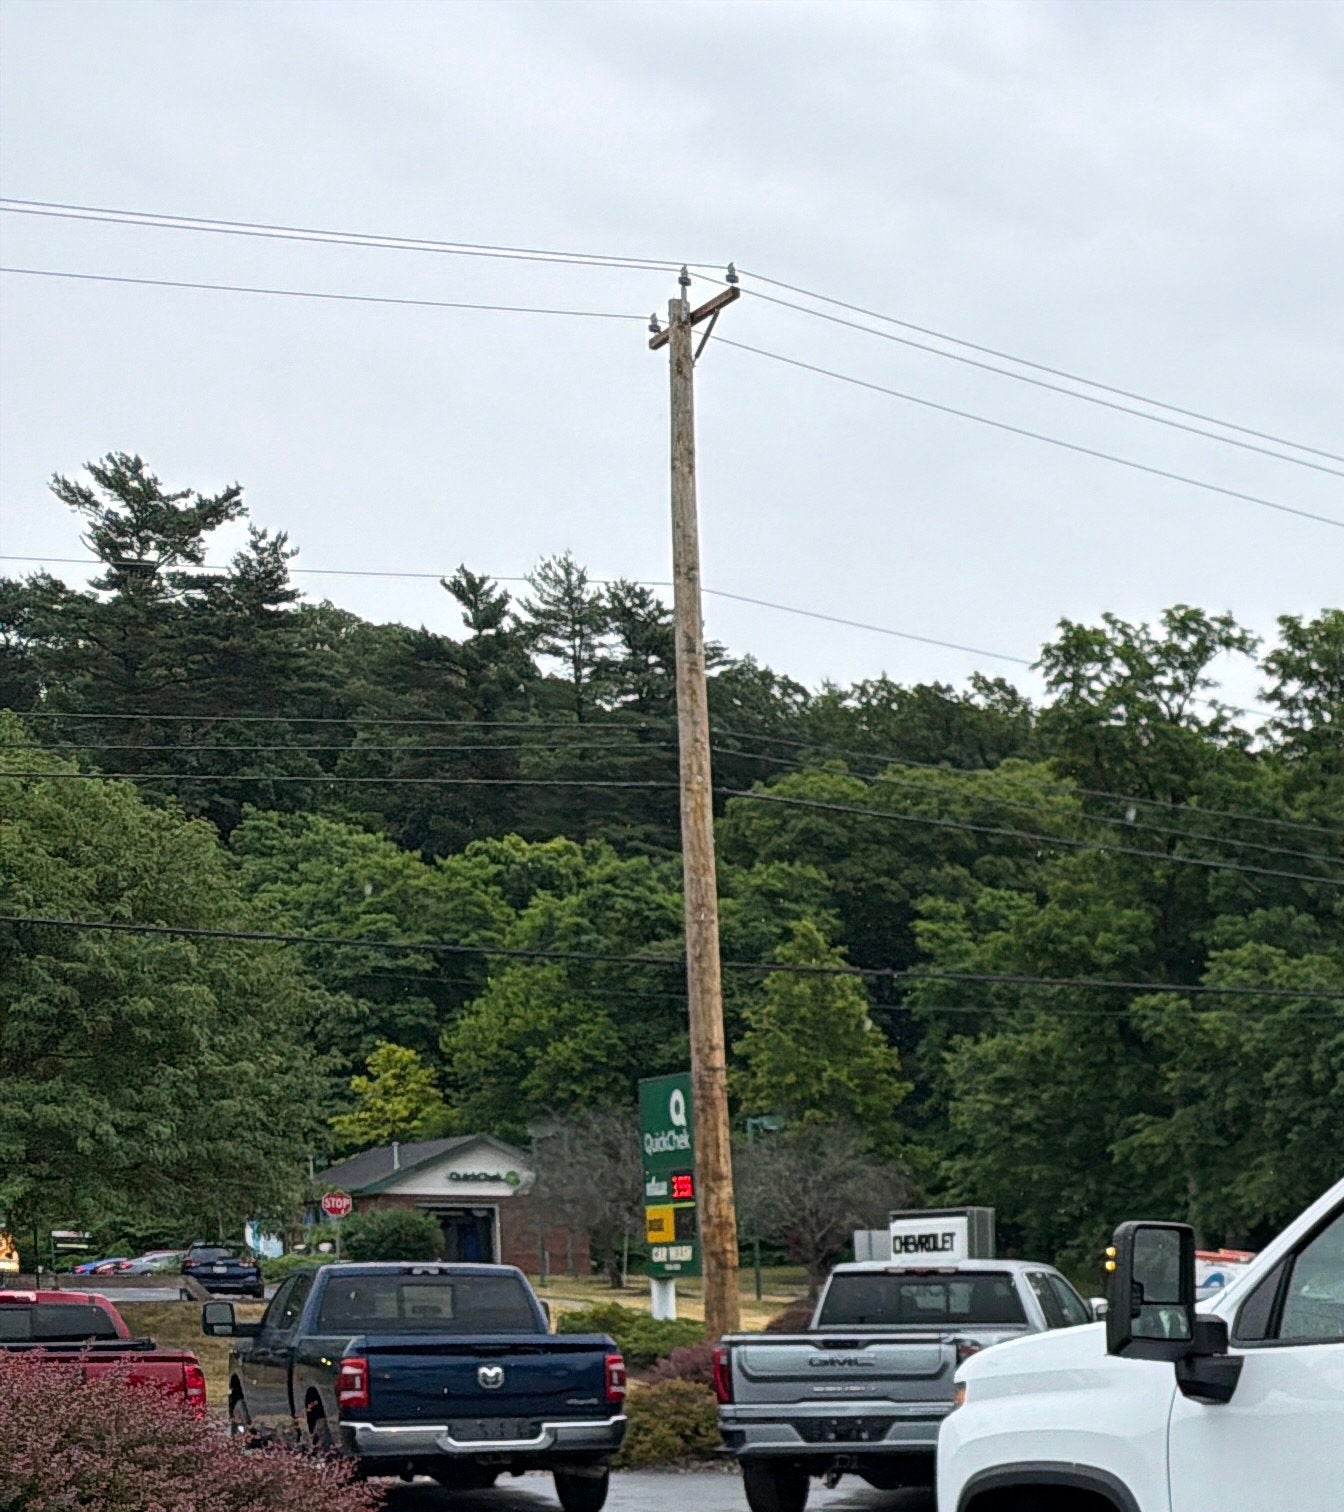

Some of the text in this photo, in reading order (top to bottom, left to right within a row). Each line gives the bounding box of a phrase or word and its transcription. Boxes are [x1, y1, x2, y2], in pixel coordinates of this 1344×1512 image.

[670, 1089, 687, 1127] Q
[644, 1129, 691, 1156] QuickChek
[324, 1196, 350, 1209] STOP
[893, 1232, 956, 1255] CHEVROLET
[651, 1245, 693, 1263] CAR WASH
[807, 1354, 876, 1368] GMC
